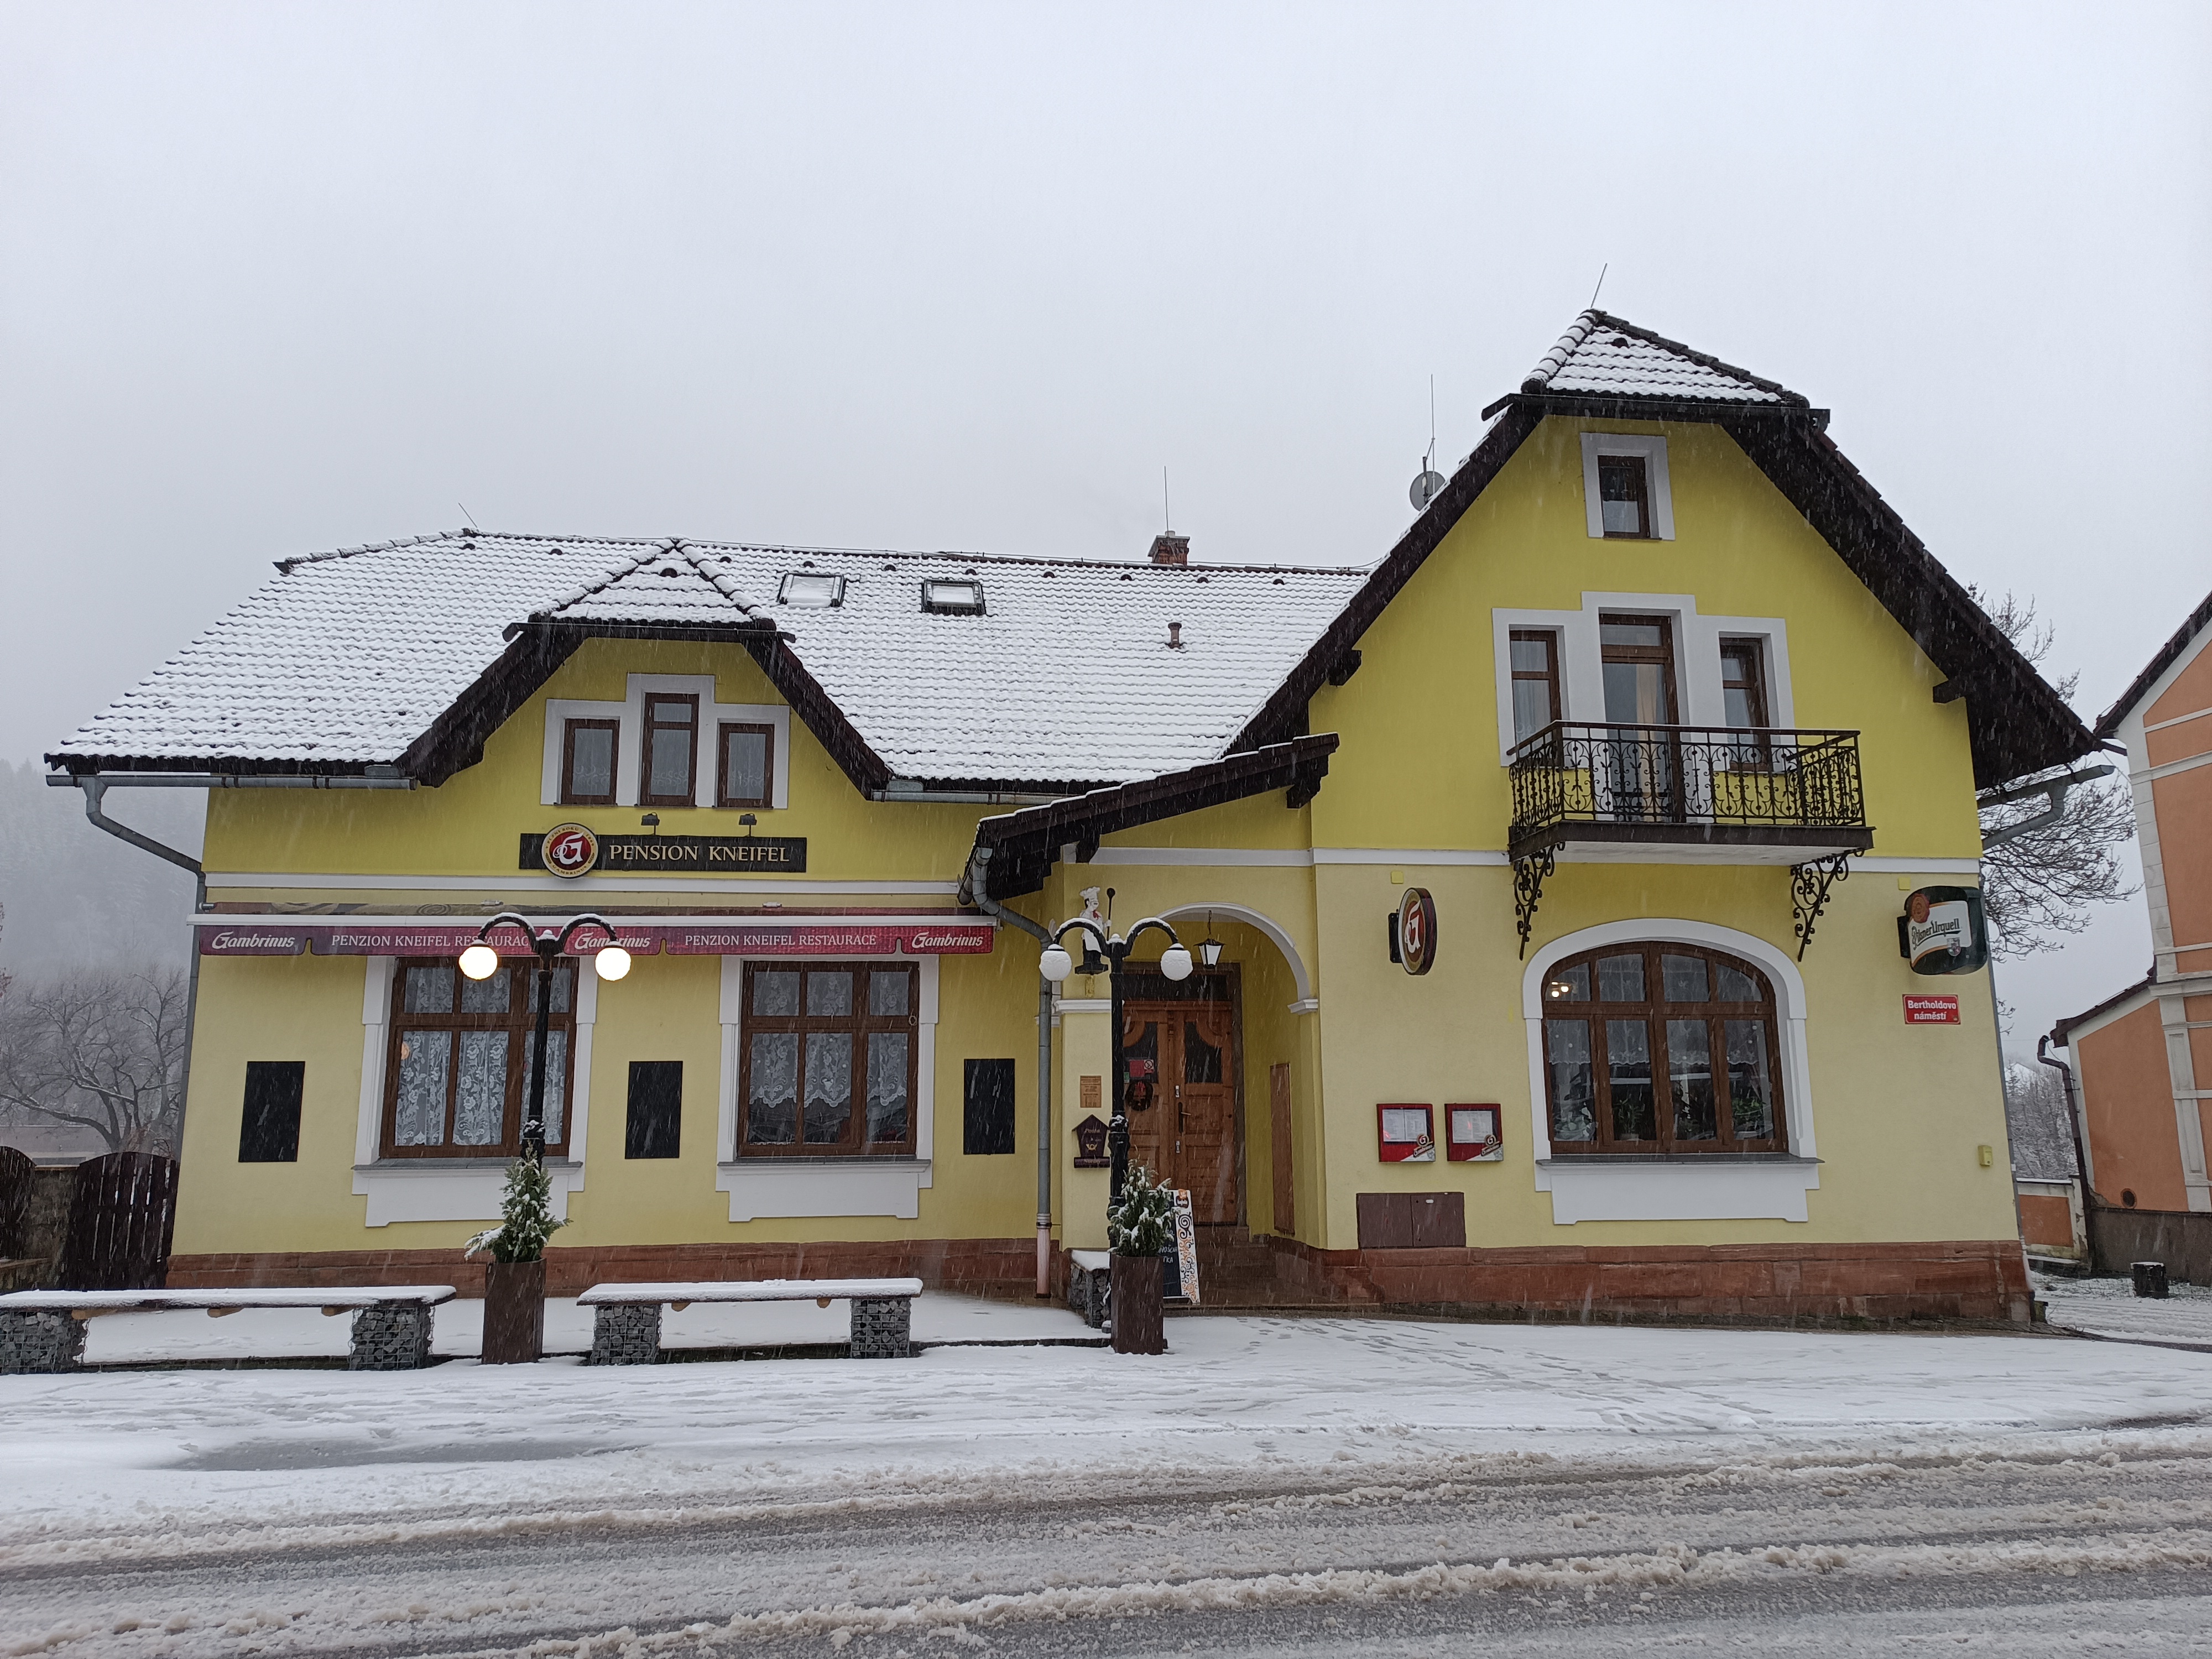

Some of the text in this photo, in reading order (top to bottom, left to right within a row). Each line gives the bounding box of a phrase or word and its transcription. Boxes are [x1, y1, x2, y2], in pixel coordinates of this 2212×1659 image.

[609, 845, 790, 862] PENSION KNEIFEL
[552, 864, 587, 875] GAMBRINUS
[212, 931, 295, 950] Gambrinus
[332, 935, 391, 946] PENZION
[395, 935, 451, 947] KNEIFEL
[575, 932, 651, 950] Gamrinus
[685, 935, 877, 946] PENZION KNEIFEL RESTAURACE
[911, 931, 983, 948] Gambrinus
[1911, 918, 1960, 951] Pilsner Urquell
[1908, 1000, 1957, 1010] Bertholdovo
[1914, 1011, 1947, 1020] náměstí
